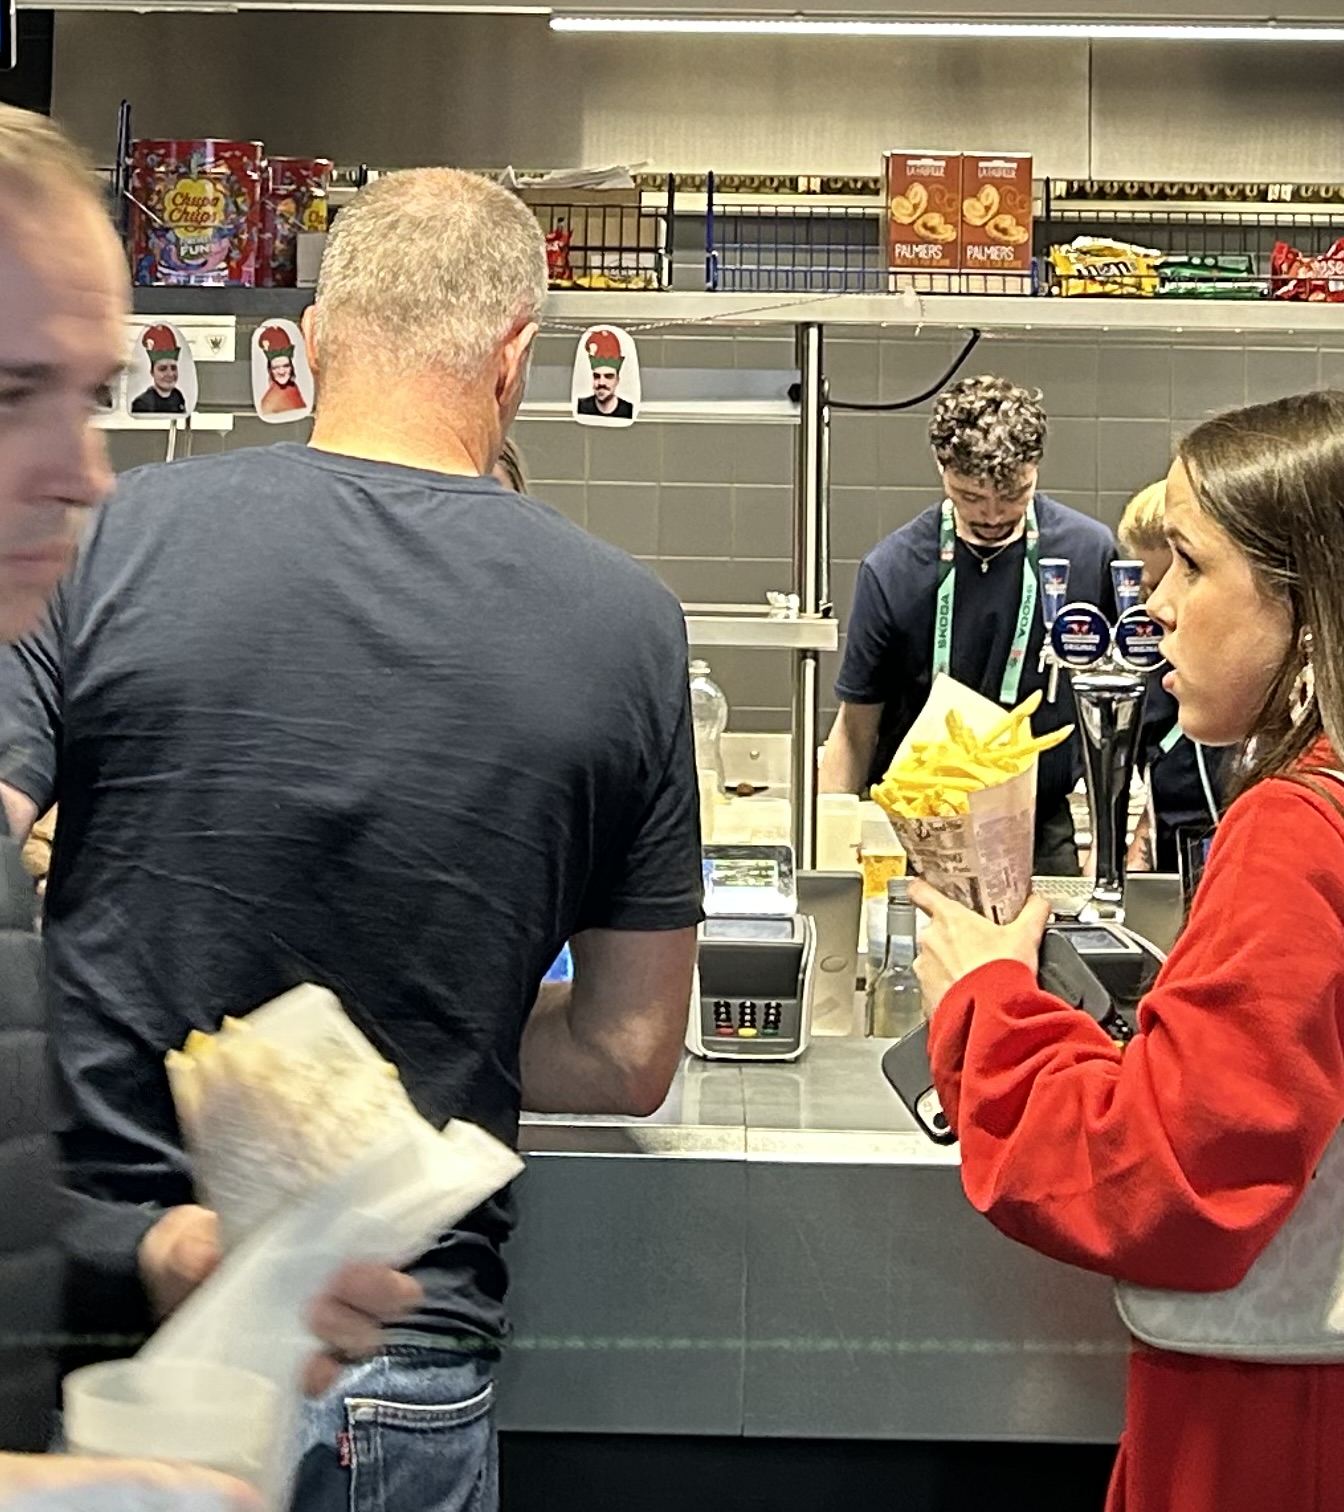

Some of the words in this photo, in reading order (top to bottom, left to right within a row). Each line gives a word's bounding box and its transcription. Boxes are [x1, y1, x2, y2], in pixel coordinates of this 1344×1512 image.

[170, 191, 221, 210] Chupa
[167, 204, 219, 226] Chups
[894, 242, 944, 260] PALMIERS
[966, 244, 1015, 261] PALMIERS
